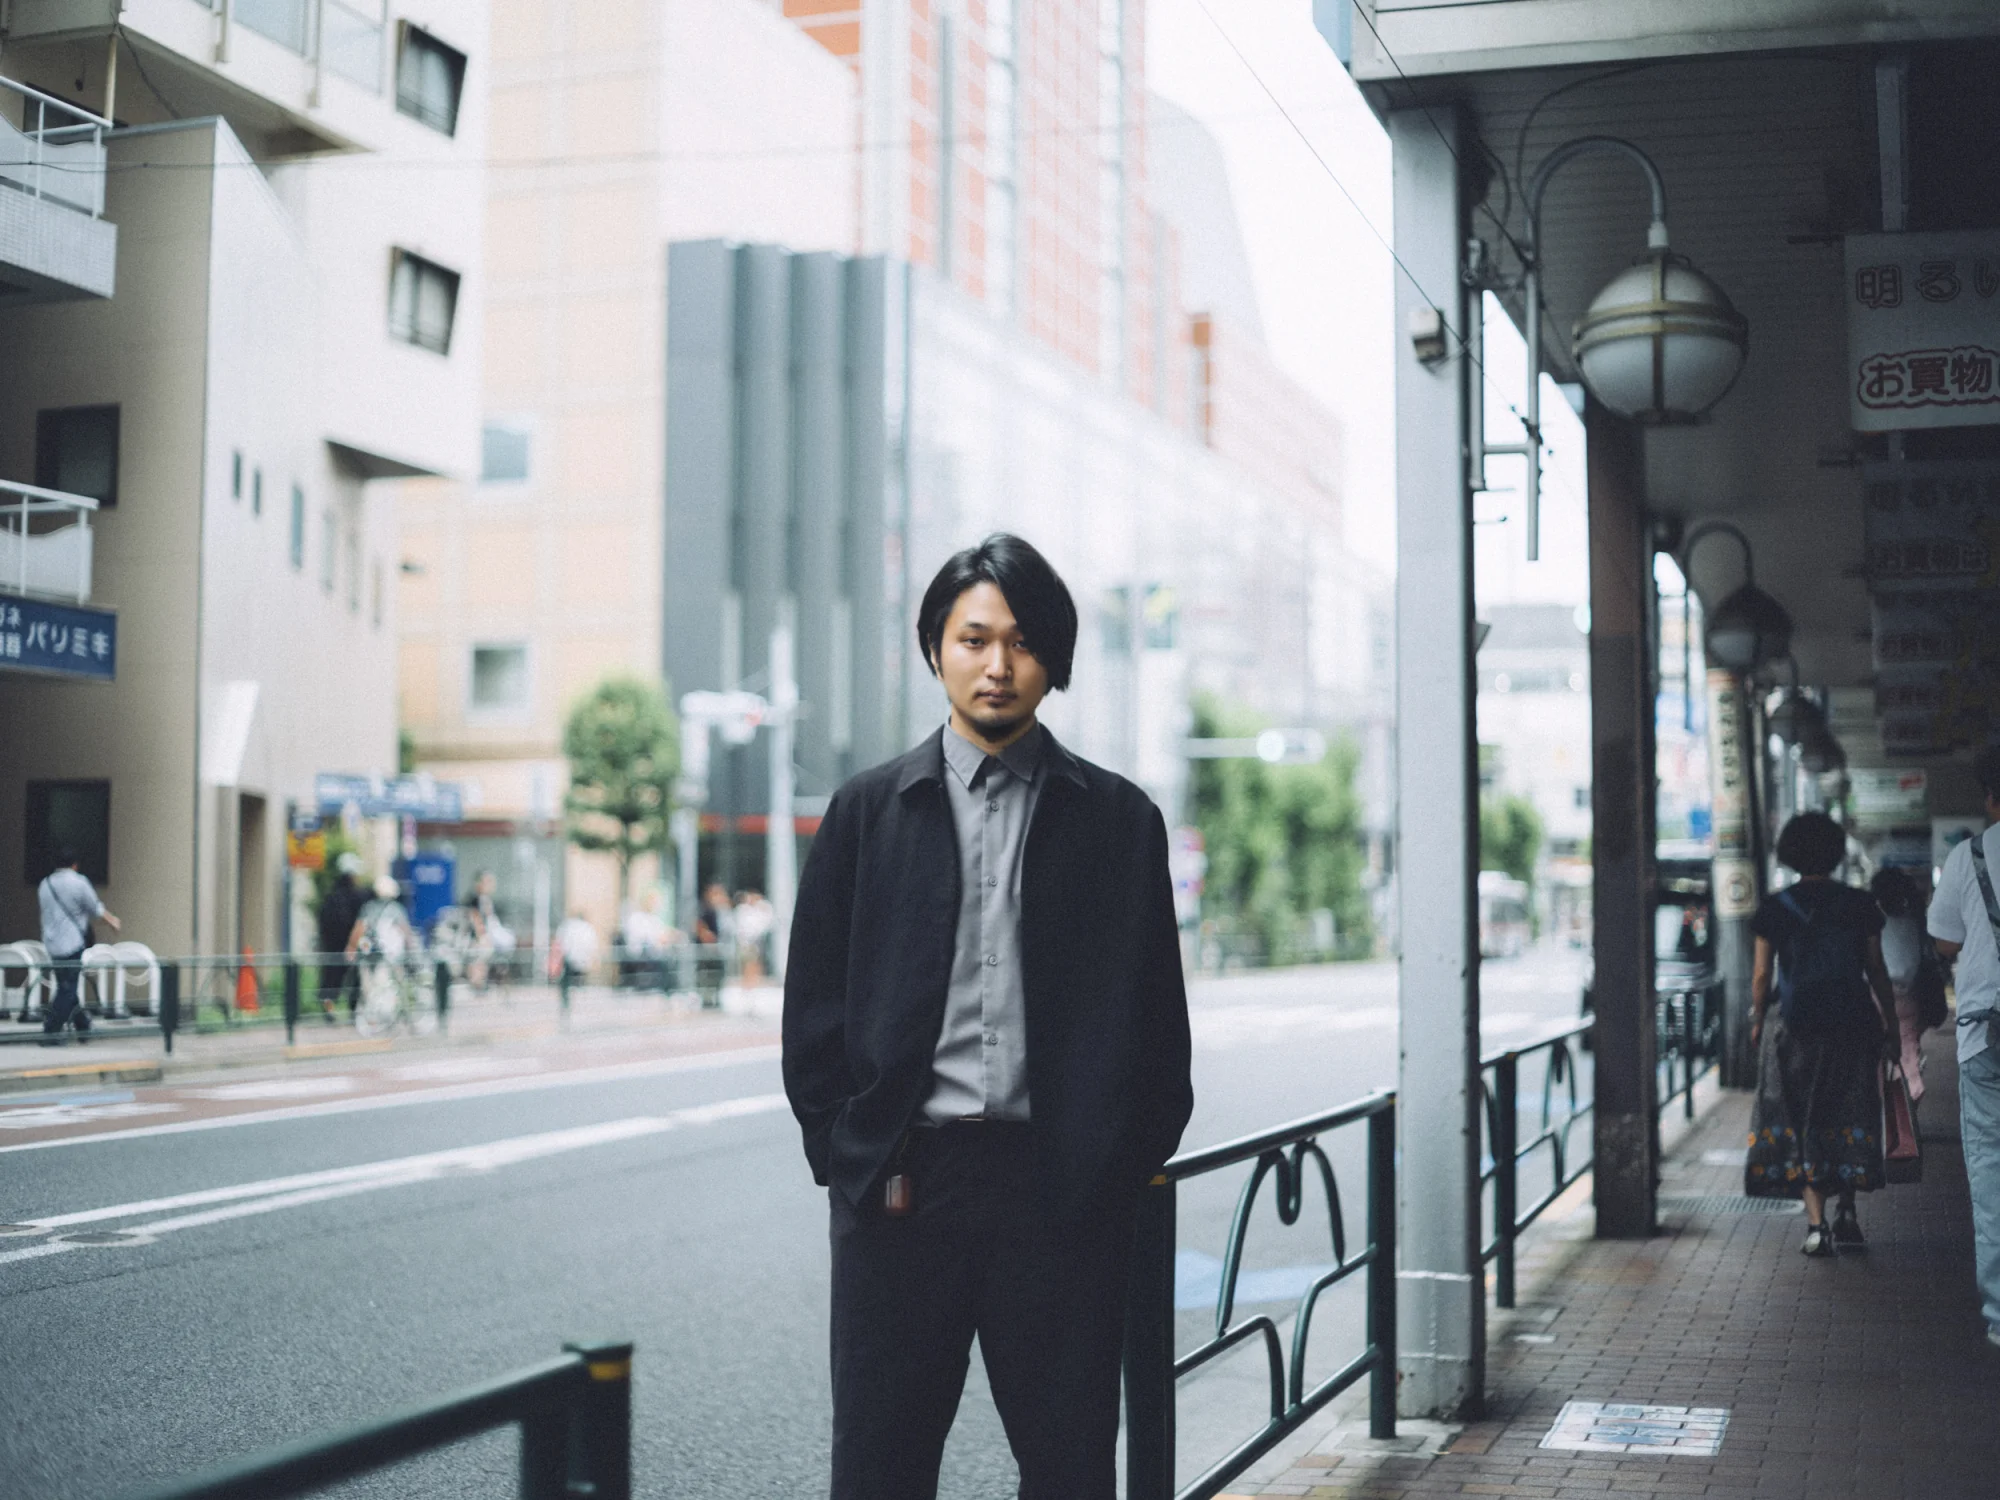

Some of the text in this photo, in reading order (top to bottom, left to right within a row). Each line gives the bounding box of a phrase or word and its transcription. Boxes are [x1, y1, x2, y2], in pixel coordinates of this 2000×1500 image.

[1865, 352, 2000, 399] お買物
[26, 620, 110, 661] パリミキ
